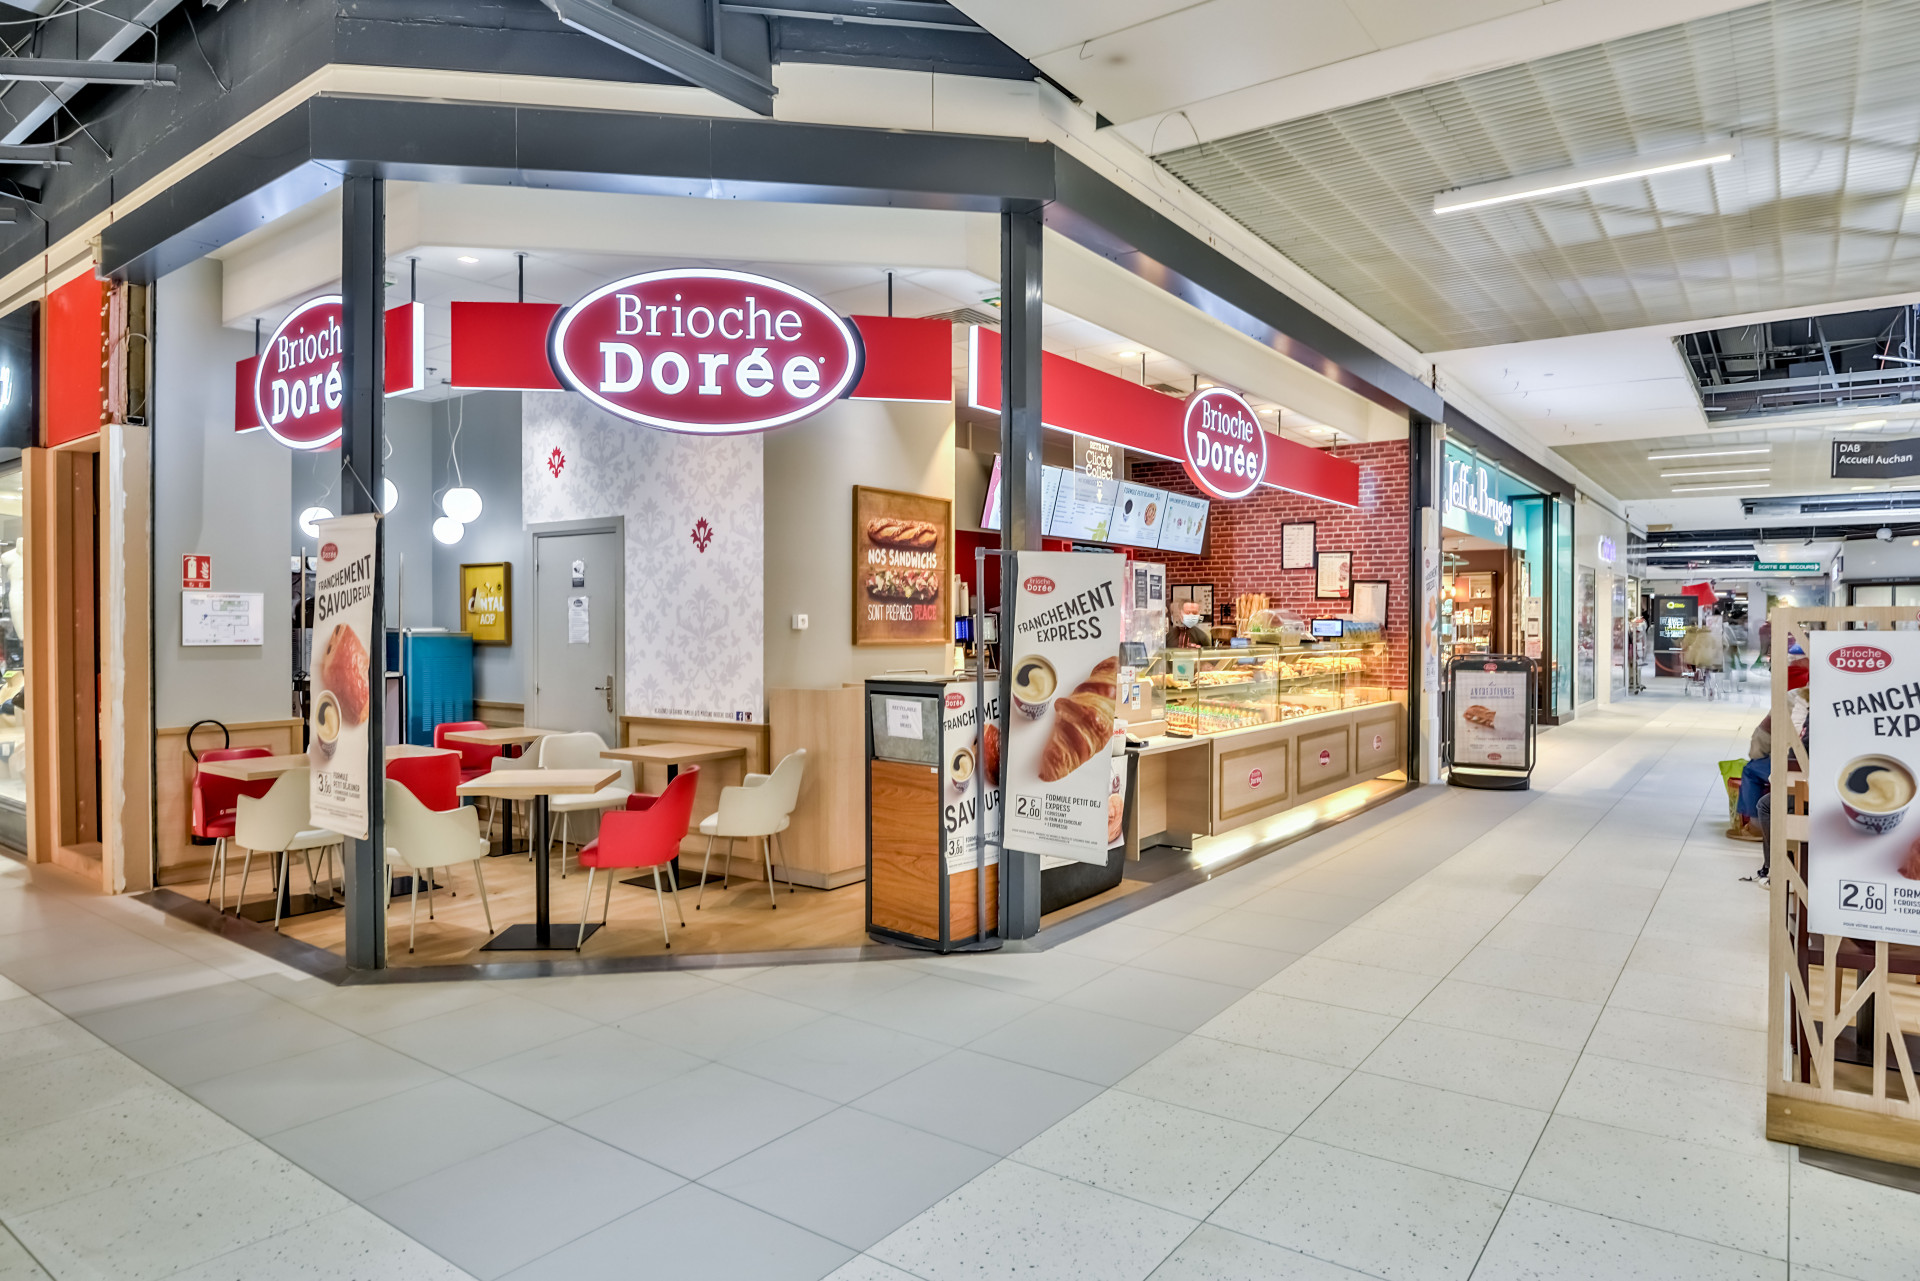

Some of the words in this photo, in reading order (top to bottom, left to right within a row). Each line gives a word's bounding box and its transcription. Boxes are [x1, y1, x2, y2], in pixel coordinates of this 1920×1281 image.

[615, 292, 803, 342] Brioche
[277, 315, 343, 373] Brioch
[599, 347, 821, 398] Dorée
[271, 361, 343, 425] Doré
[1201, 399, 1254, 443] Brioche
[1085, 449, 1106, 467] Click
[1089, 440, 1110, 453] RETRAIT
[1196, 430, 1259, 480] Dorée
[1839, 443, 1861, 453] DAB
[1838, 455, 1874, 464] Accueil
[1875, 453, 1913, 465] Auchan
[1085, 464, 1114, 481] Collect
[1443, 460, 1473, 514] Jeff
[1468, 483, 1478, 513] de
[1477, 466, 1512, 537] Bruges
[867, 548, 887, 567] NOS
[888, 549, 937, 570] SANDWICHS
[318, 554, 372, 591] FRANCHEMENT
[1026, 583, 1053, 592] Dorée
[318, 584, 372, 622] SAVOUREUX
[867, 603, 884, 621] SONT
[885, 602, 913, 621] PRÉPARÉS
[1017, 580, 1115, 635] FRANCHEMENT
[480, 613, 496, 625] AOP
[1036, 616, 1102, 643] EXPRESS
[1836, 658, 1886, 669] Dorée
[1839, 648, 1882, 658] Brioche
[1831, 681, 1920, 718] FRANCH
[1873, 713, 1920, 738] EXP
[1045, 793, 1072, 805] FORMULE
[1072, 798, 1089, 807] PETIT
[1089, 800, 1101, 809] DEJ
[1045, 802, 1071, 813] EXPRESS
